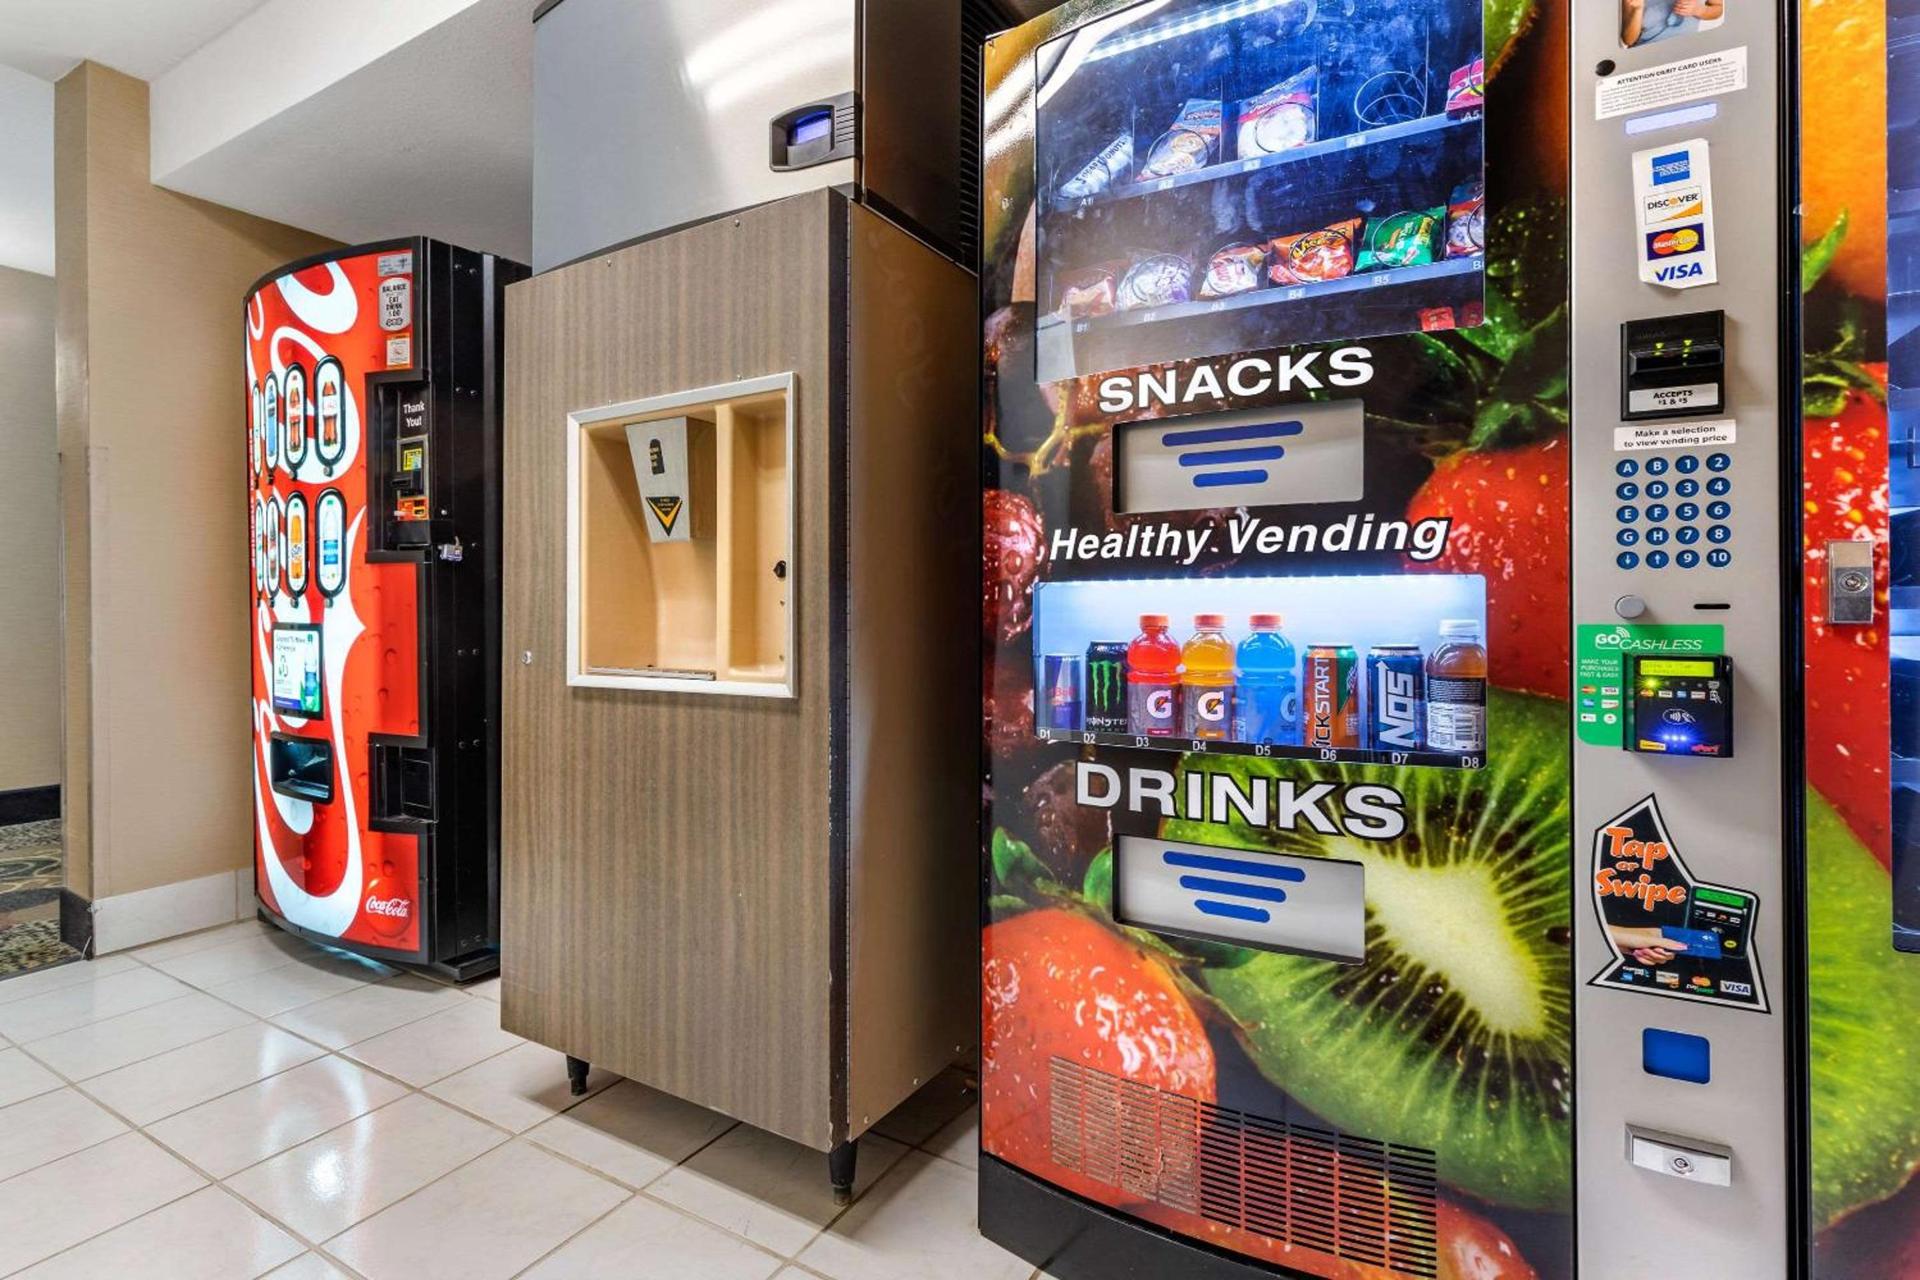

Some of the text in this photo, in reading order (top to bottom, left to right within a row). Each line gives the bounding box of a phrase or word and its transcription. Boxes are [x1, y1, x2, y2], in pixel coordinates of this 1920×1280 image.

[1617, 71, 1655, 84] ATTENTION
[1677, 62, 1698, 71] CARD
[1699, 57, 1722, 66] USERS
[1648, 193, 1698, 210] DISCOVER
[1374, 276, 1389, 285] B5
[1473, 261, 1484, 270] B
[1655, 262, 1703, 281] VISA
[382, 284, 407, 293] BALANCE
[1099, 346, 1375, 413] SNACKS
[1653, 390, 1693, 399] ACCEPTS
[403, 401, 425, 414] Thank
[406, 416, 422, 428] You!
[1635, 430, 1660, 438] Make
[1671, 426, 1716, 435] selection
[1636, 439, 1658, 447] view
[1660, 436, 1699, 446] vending
[1702, 434, 1728, 443] price
[1623, 457, 1723, 473] A B 1 2
[1623, 481, 1723, 496] C D 3 4
[1624, 505, 1723, 519] E F 5 6
[1050, 513, 1449, 565] Healthy Vending
[1623, 529, 1724, 542] G H 7 8
[1683, 552, 1727, 563] 9 10
[1595, 633, 1703, 650] GO CASHLESS
[1147, 690, 1173, 718] G
[1198, 691, 1224, 721] G
[1379, 667, 1416, 748] NOS
[1087, 716, 1128, 727] MONSTE
[1040, 729, 1479, 769] D1 D2 D3 D4 D5 D6 D7 D8
[1077, 762, 1407, 839] DRINKS
[1606, 826, 1669, 870] Tap
[1616, 862, 1639, 871] or
[1595, 868, 1687, 911] Swipe
[366, 895, 410, 917] Coca-Cola
[1724, 983, 1750, 994] VISA
